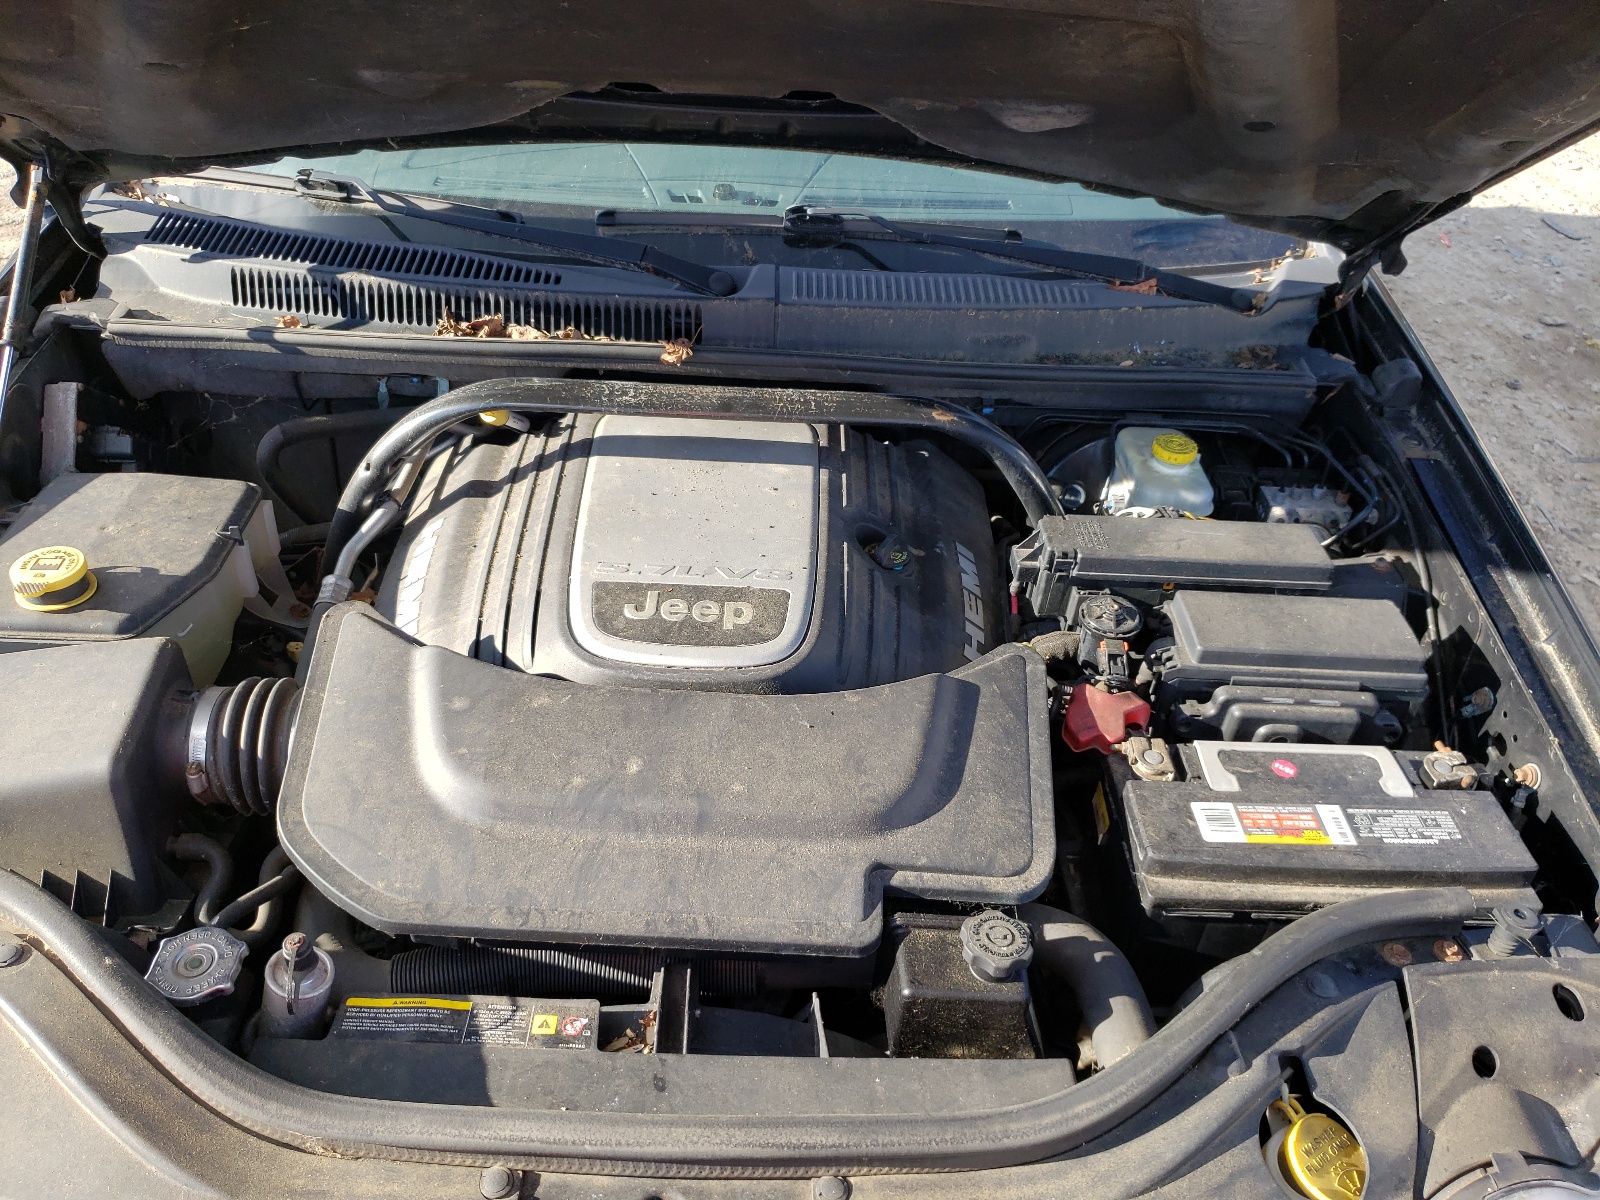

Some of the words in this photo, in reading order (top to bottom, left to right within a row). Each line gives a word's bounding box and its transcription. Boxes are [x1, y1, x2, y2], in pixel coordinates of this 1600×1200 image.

[714, 565, 793, 581] V8
[624, 590, 755, 630] Jeep
[955, 541, 985, 662] HEMI
[183, 930, 212, 943] OPEN
[1300, 1126, 1335, 1158] WASHER
[1303, 1152, 1330, 1177] FLUID
[1328, 1134, 1351, 1157] ONLY
